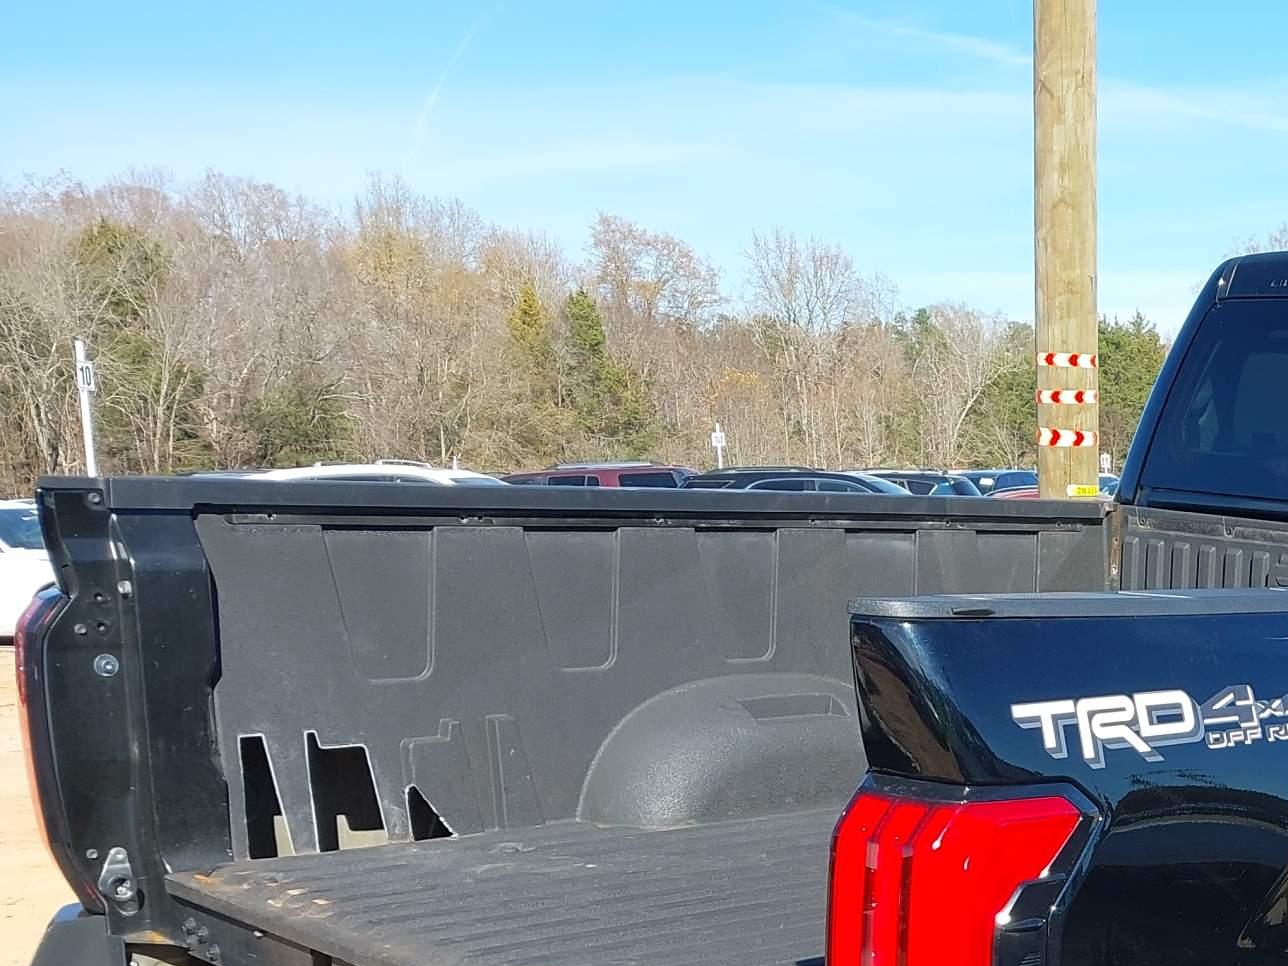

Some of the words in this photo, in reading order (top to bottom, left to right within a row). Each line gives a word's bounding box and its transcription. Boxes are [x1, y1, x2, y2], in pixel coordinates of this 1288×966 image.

[79, 365, 92, 386] 10
[1010, 689, 1205, 769] TRD
[1205, 728, 1263, 750] OFF
